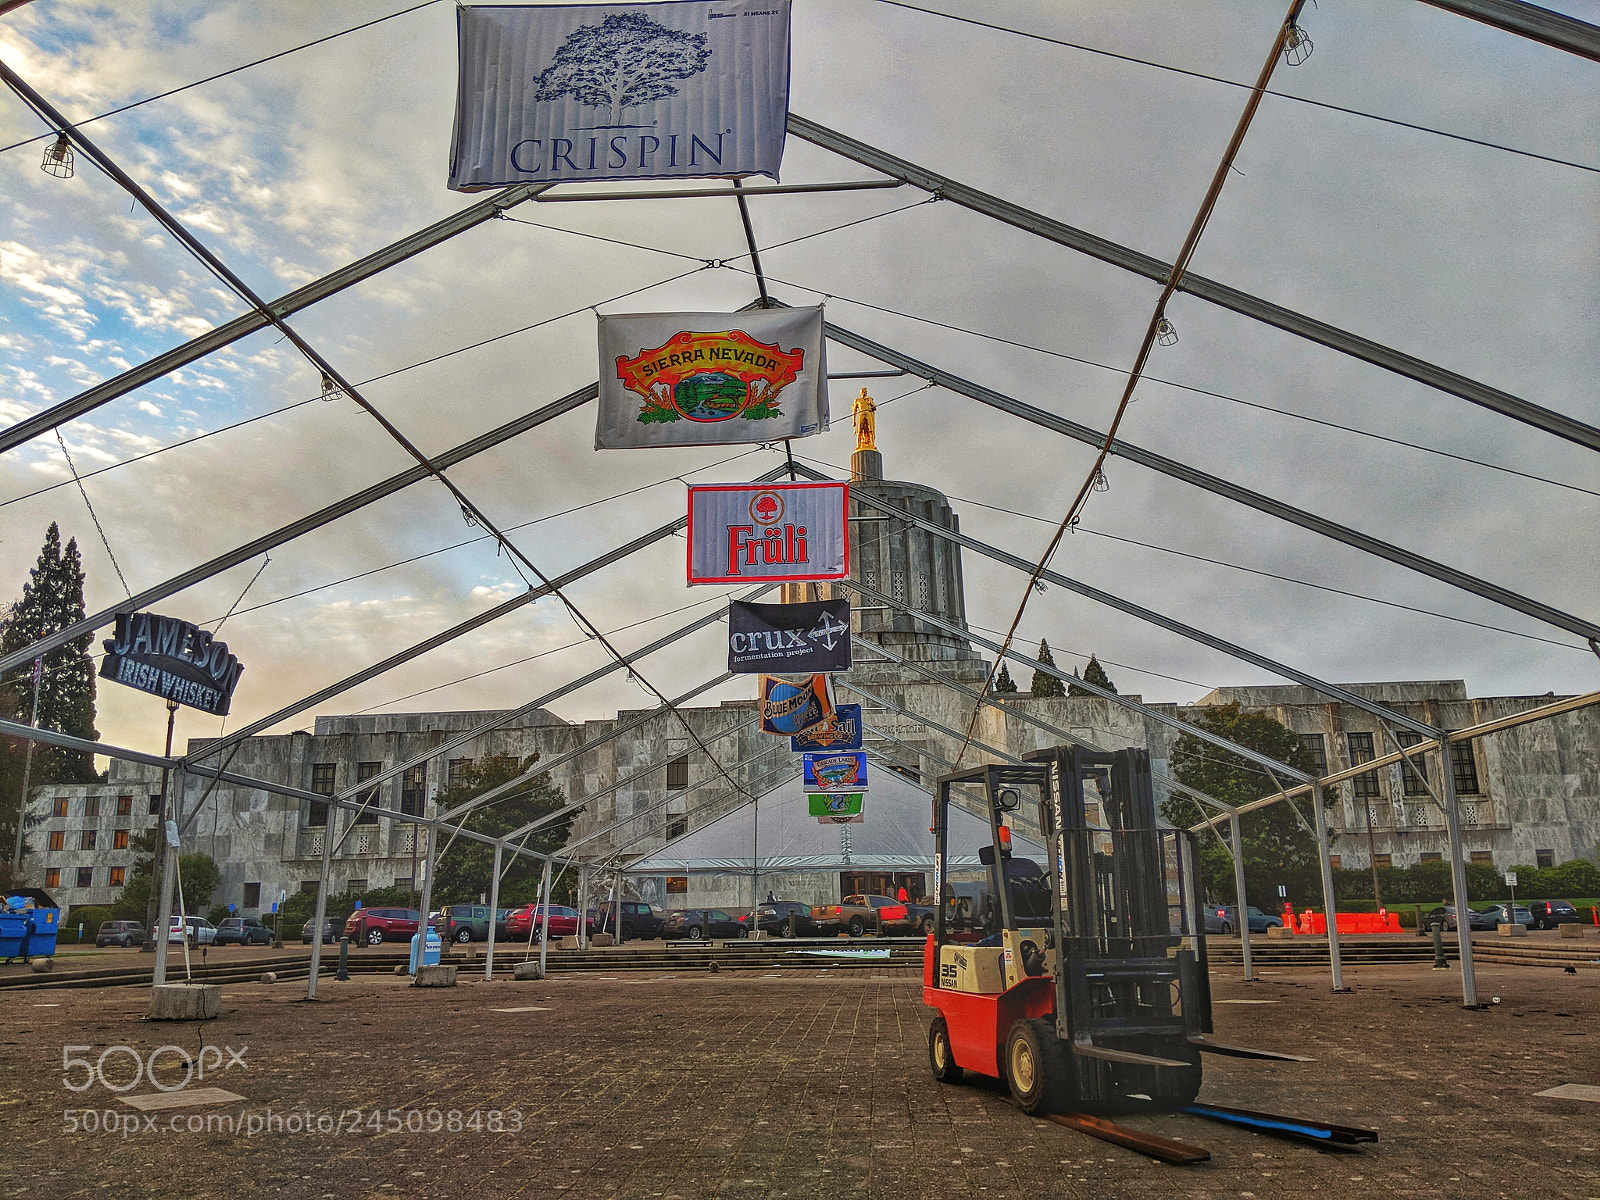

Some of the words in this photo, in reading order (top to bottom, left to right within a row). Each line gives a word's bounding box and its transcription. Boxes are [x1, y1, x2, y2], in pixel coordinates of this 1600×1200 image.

[510, 132, 725, 174] CRISPIN
[642, 348, 705, 377] SIERRA
[709, 347, 778, 372] NEVADA
[726, 523, 809, 576] Früli
[113, 613, 238, 696] JAMESON
[730, 628, 807, 653] crux
[734, 652, 784, 662] fermentation
[786, 647, 814, 657] project
[116, 656, 160, 692] IRISH
[161, 670, 222, 712] WHISKEY
[764, 701, 787, 718] BLUE
[788, 685, 813, 711] MOON
[831, 718, 856, 736] Sail
[1051, 760, 1062, 829] NISSAN
[941, 963, 958, 978] 35
[941, 978, 958, 989] NISSAN
